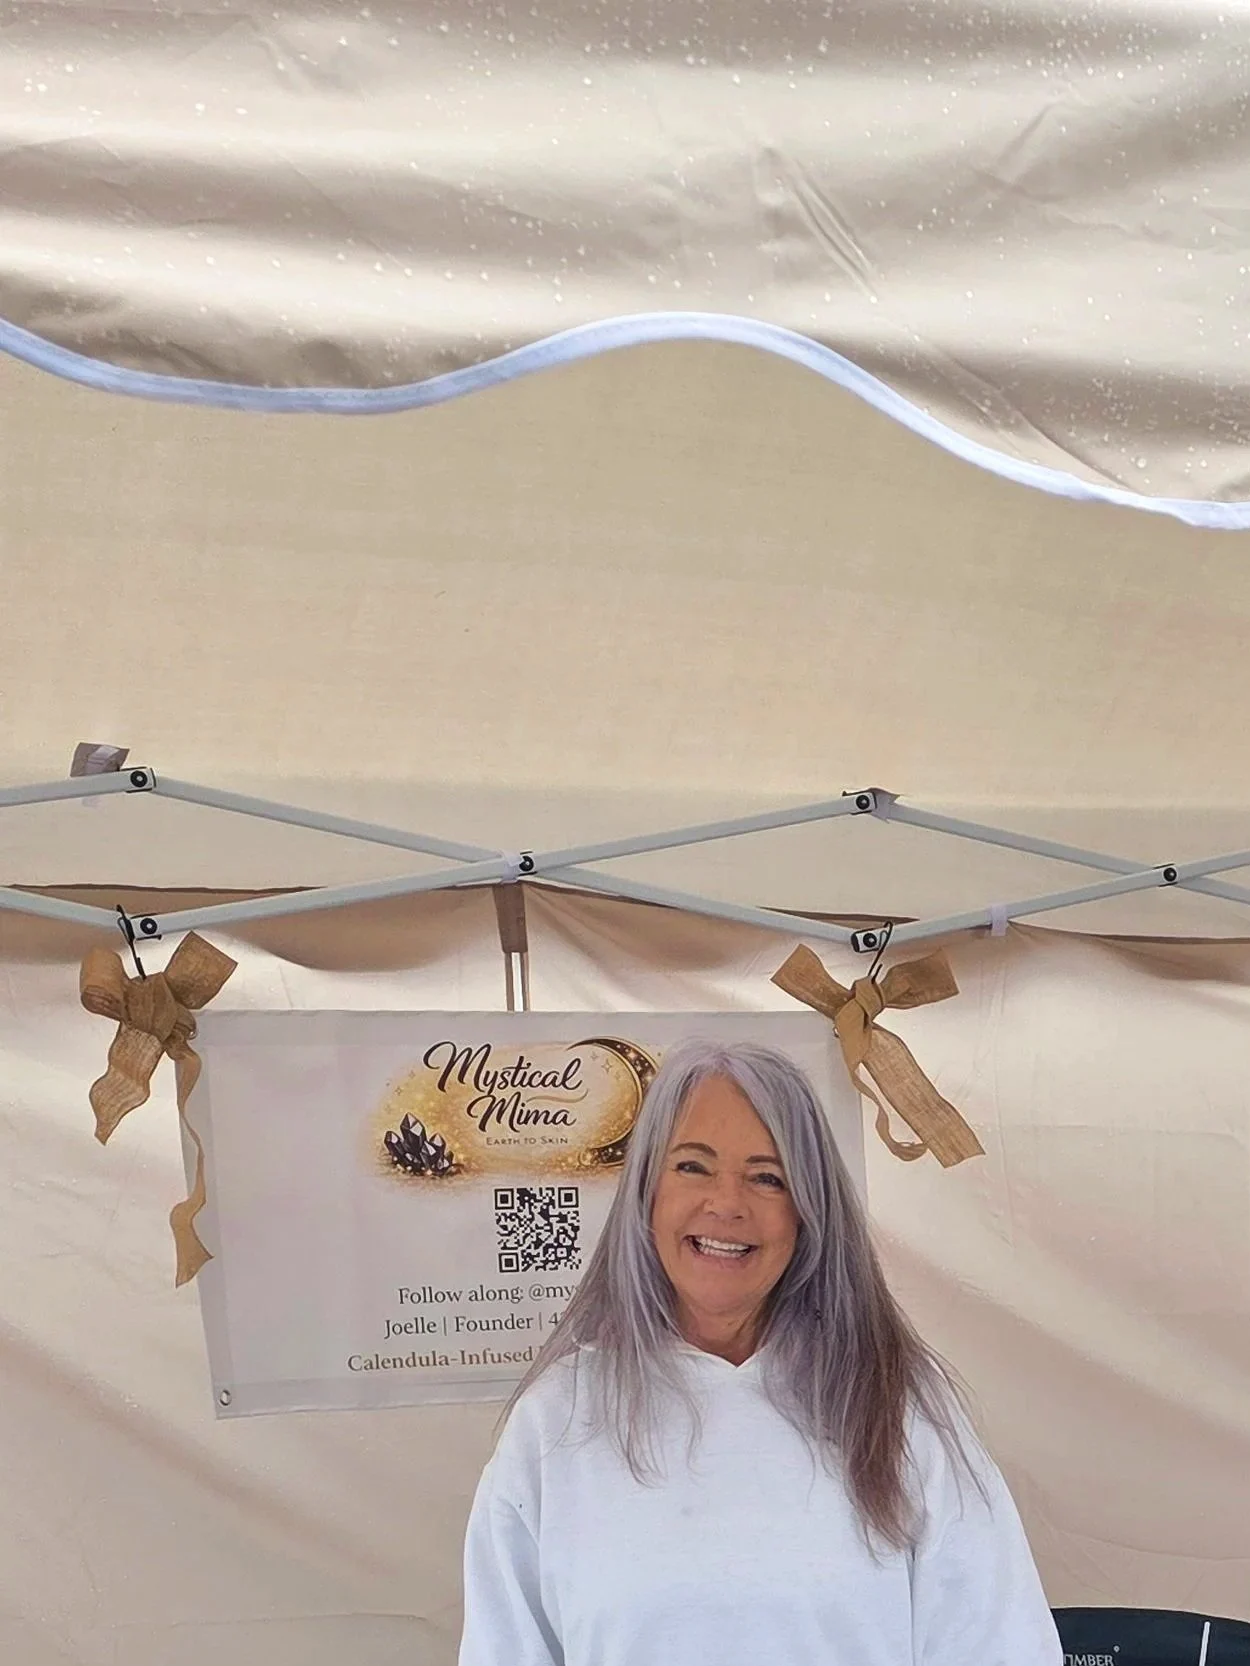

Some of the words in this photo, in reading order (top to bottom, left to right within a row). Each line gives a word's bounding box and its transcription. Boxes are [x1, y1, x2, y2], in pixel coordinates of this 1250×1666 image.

[423, 1041, 583, 1094] Mystical
[466, 1091, 577, 1133] Mima
[398, 1285, 463, 1305] Follow
[467, 1284, 524, 1303] along:
[528, 1283, 578, 1302] @my
[383, 1316, 438, 1340] Joelle
[454, 1313, 534, 1334] Founder
[347, 1346, 534, 1373] Calendula-Infused
